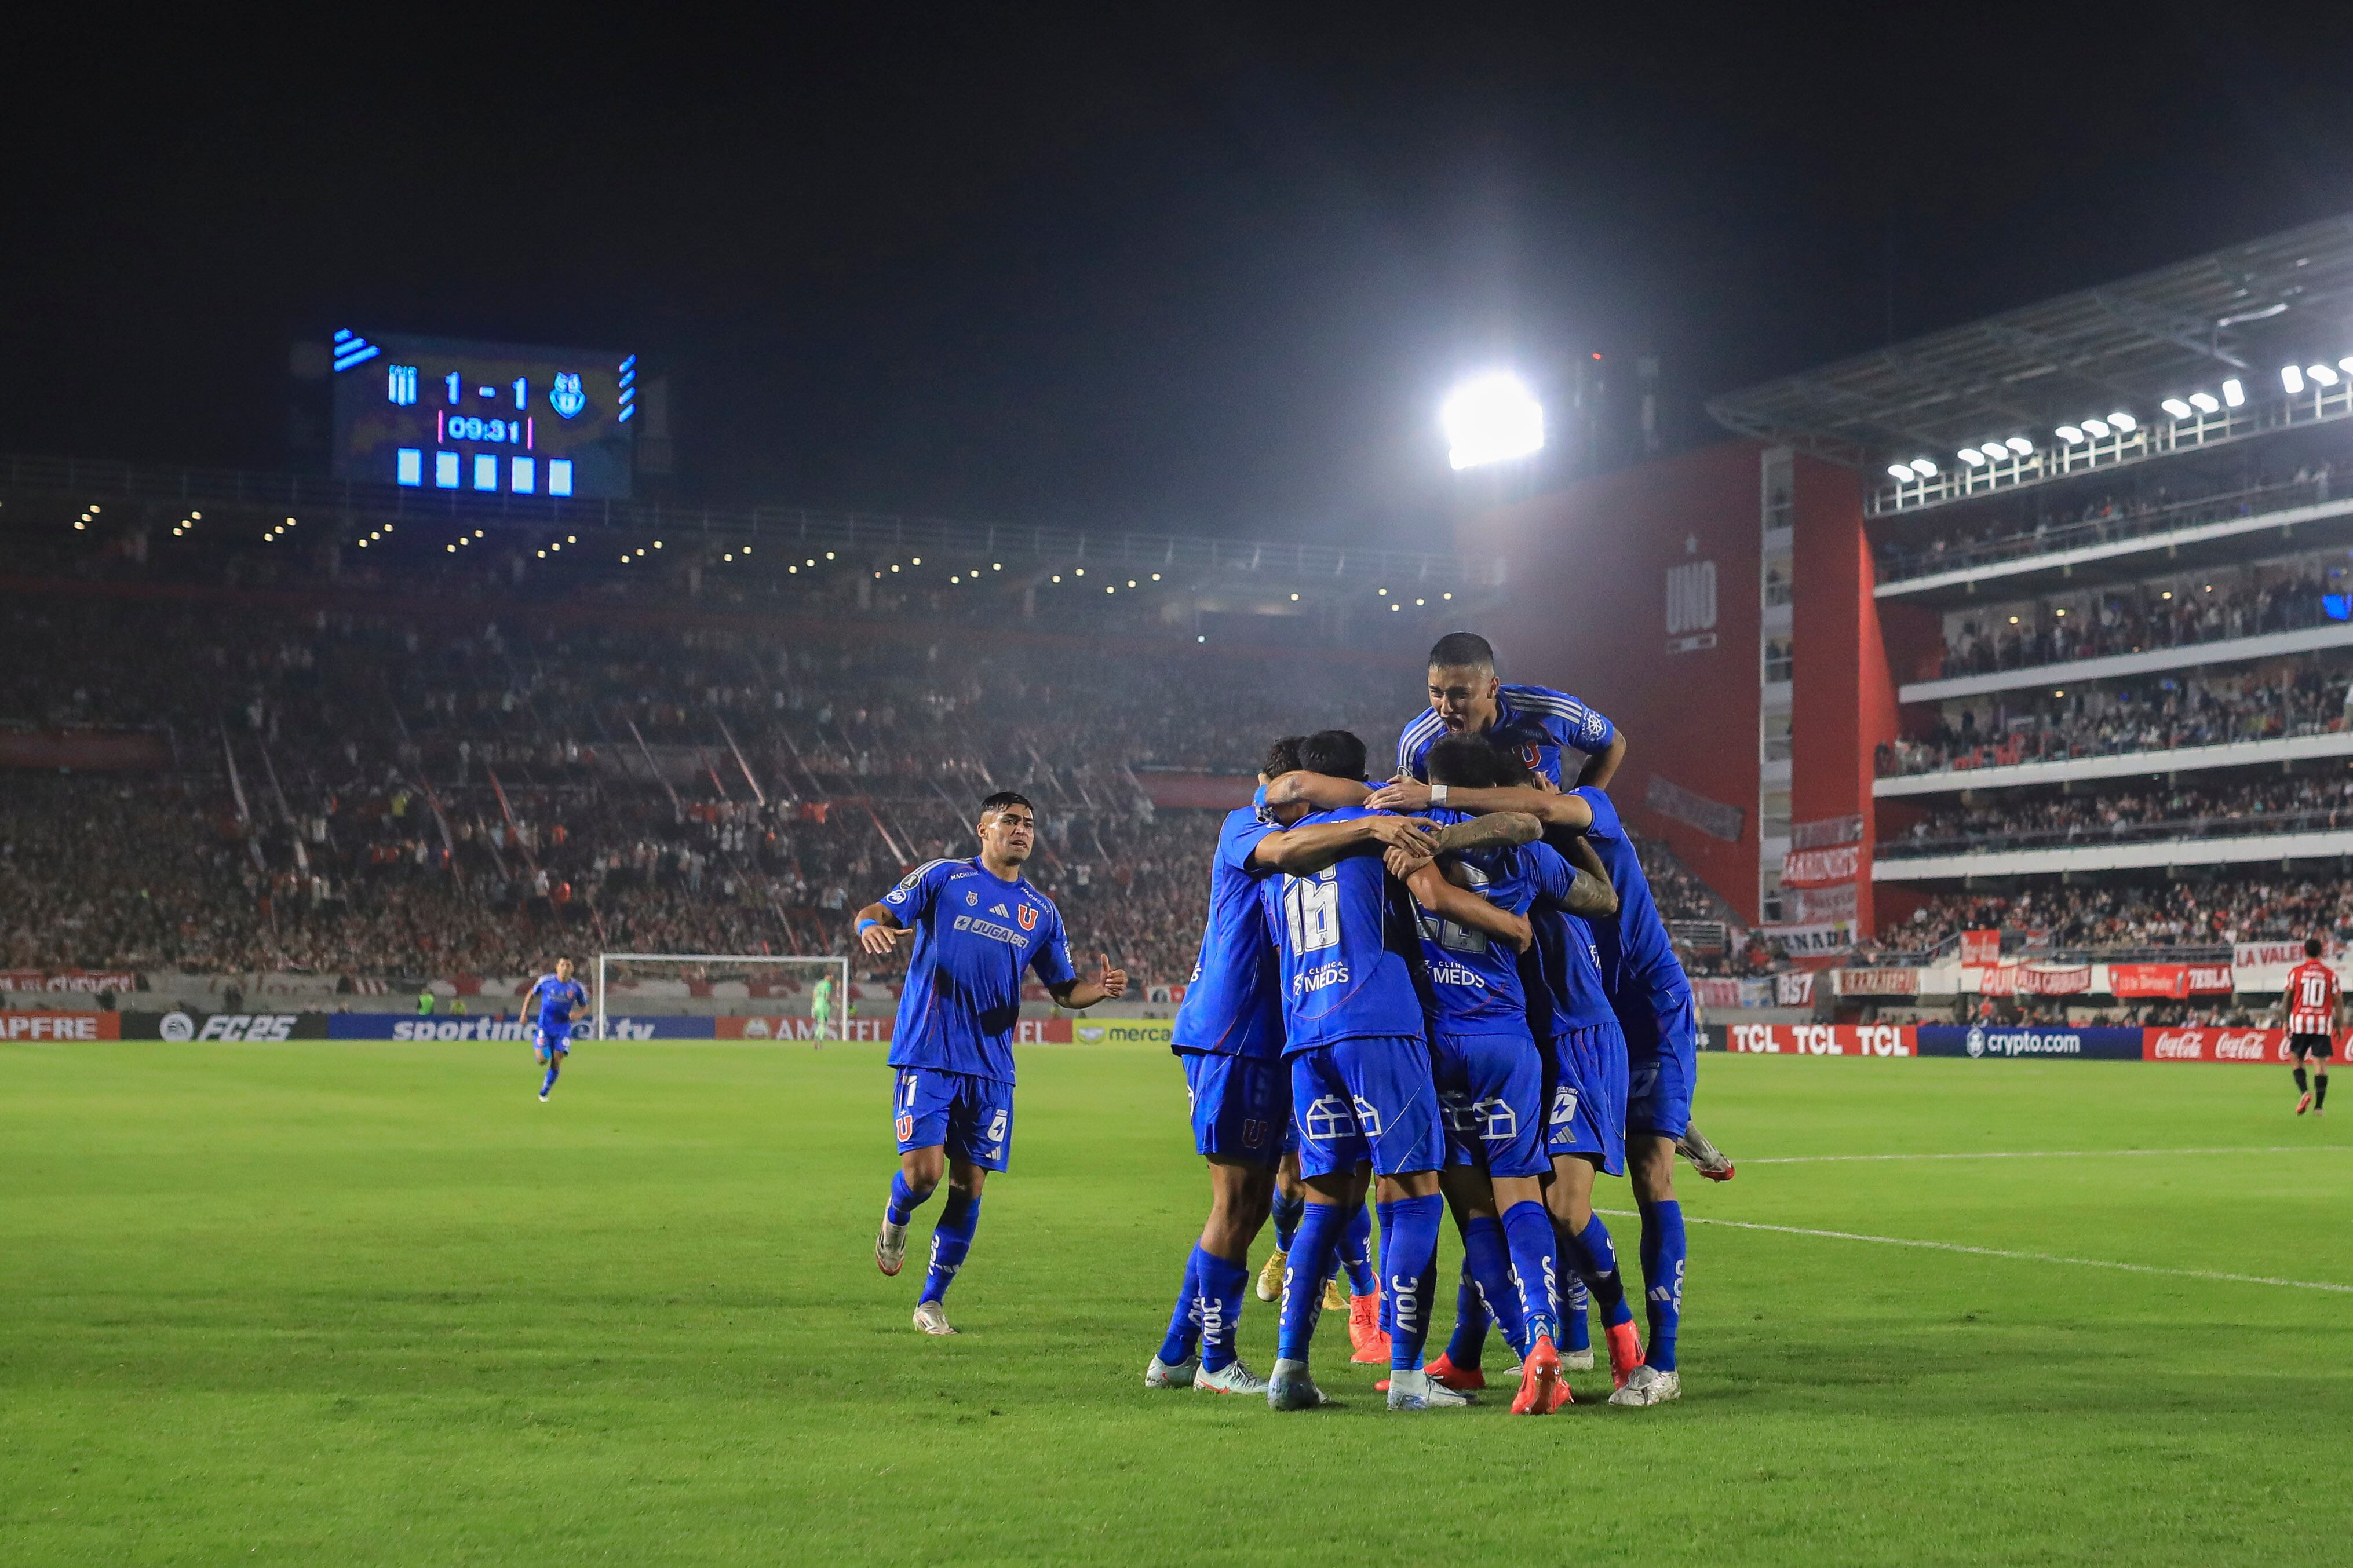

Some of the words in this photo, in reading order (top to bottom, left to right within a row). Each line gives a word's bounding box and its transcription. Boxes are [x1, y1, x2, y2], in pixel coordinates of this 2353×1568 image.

[445, 371, 460, 405] 1
[512, 377, 528, 411] 1
[448, 415, 519, 444] 09:31
[950, 871, 979, 880] MACHBANK
[1020, 887, 1050, 915] MACHBANK
[1017, 904, 1038, 931] U
[2237, 950, 2255, 968] LA
[1304, 968, 1350, 993] MEDS
[1433, 967, 1485, 988] MEDS
[2301, 977, 2326, 1007] 10
[0, 1016, 97, 1039] PFRE
[1108, 1028, 1174, 1042] merca
[1732, 1024, 1780, 1054] TCL
[1792, 1024, 1843, 1055] TCL
[1856, 1025, 1910, 1057] TCL
[1987, 1030, 2081, 1057] crypto.com
[895, 1114, 913, 1143] U
